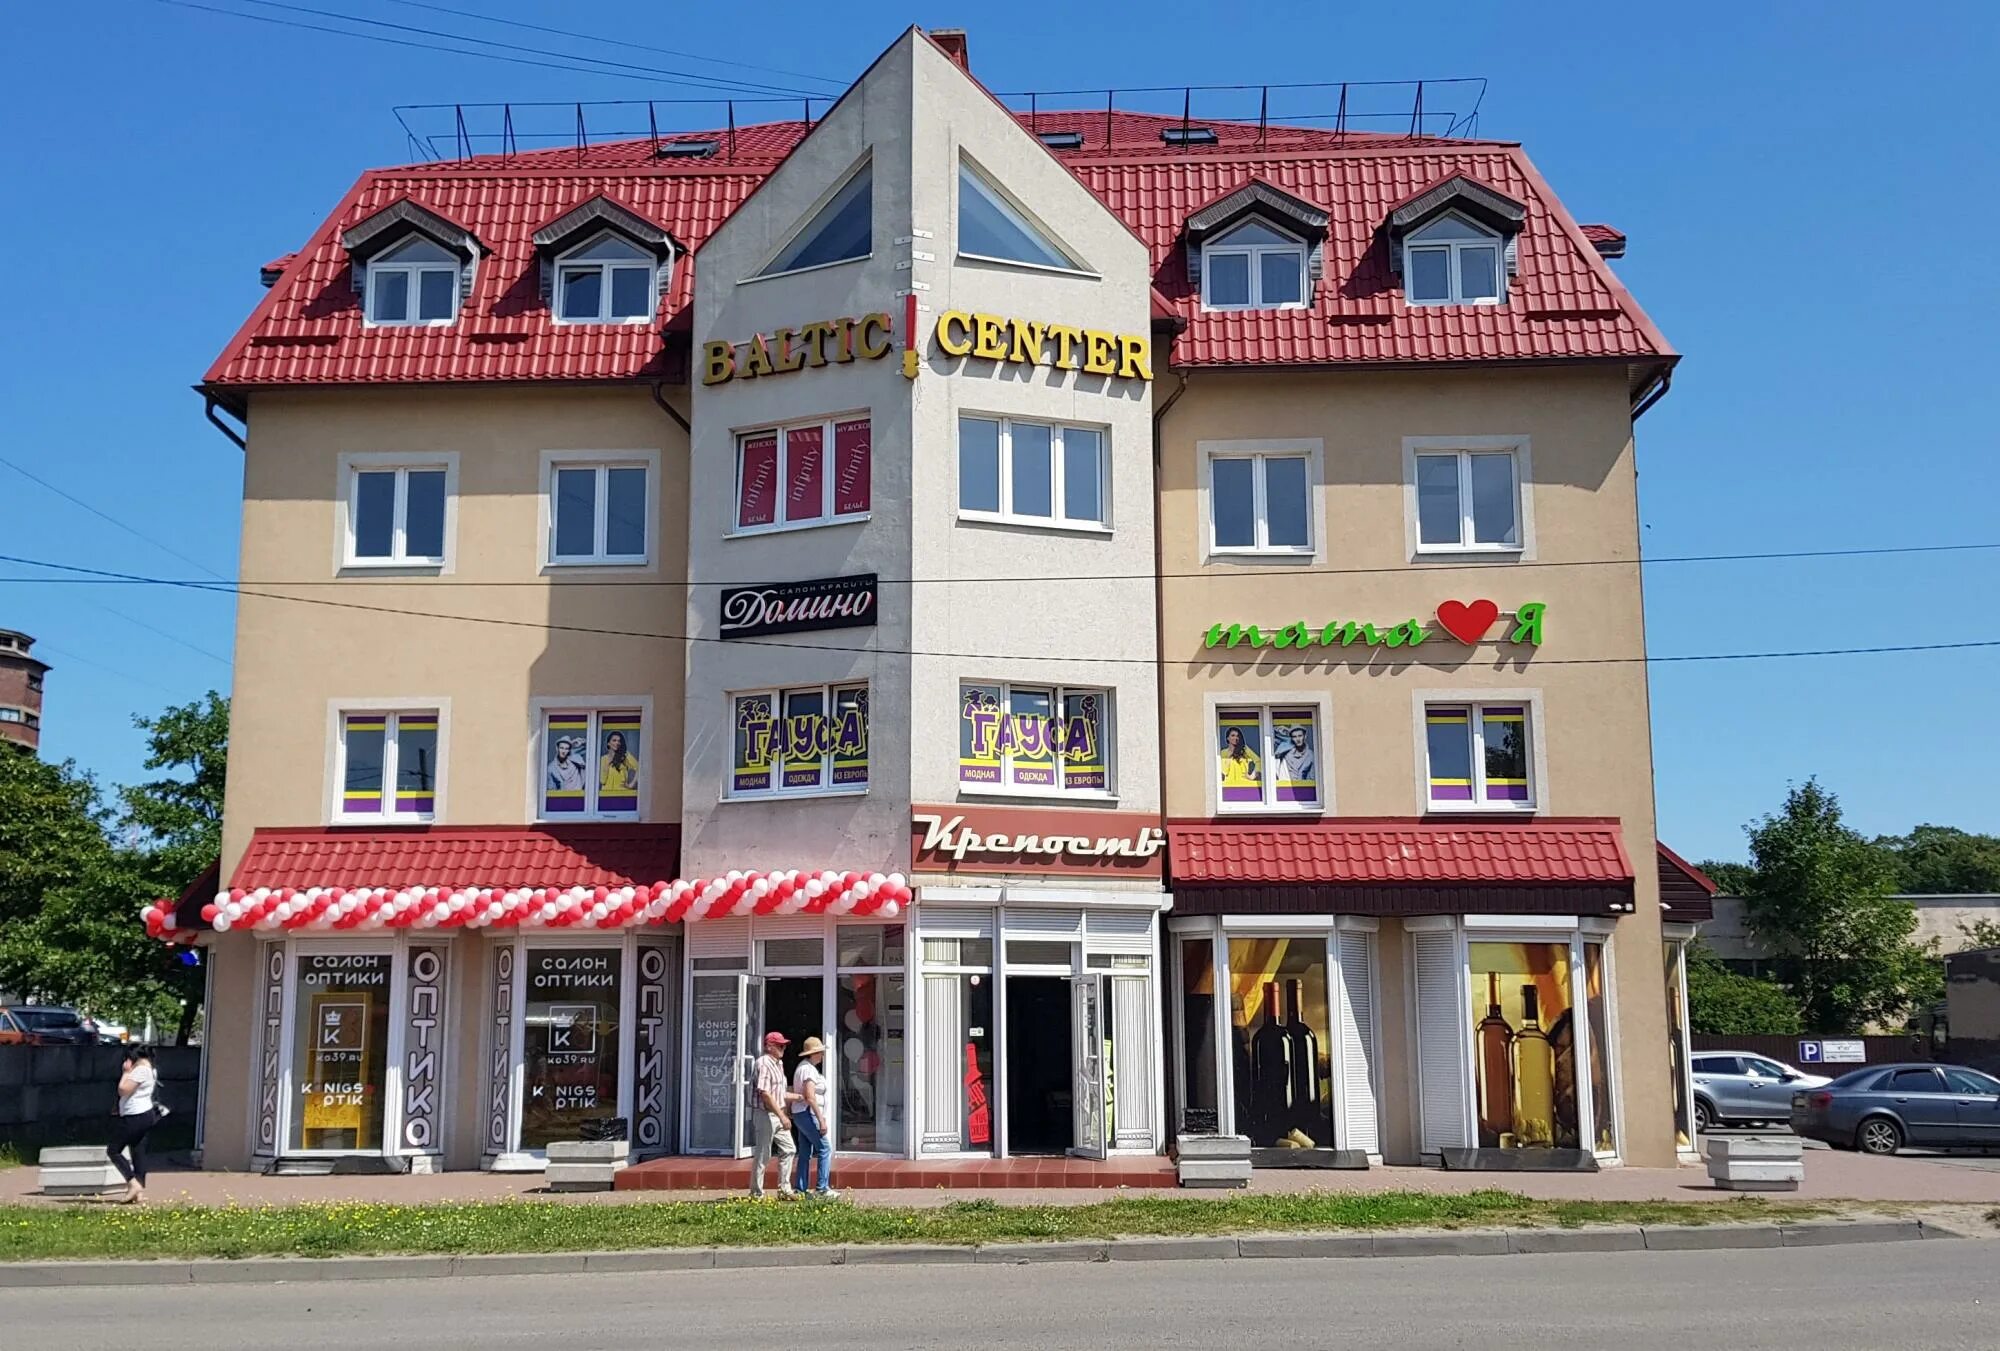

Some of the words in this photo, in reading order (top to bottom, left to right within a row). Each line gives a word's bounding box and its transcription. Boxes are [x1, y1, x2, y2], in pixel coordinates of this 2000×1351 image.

[703, 312, 893, 385] BALTIC
[937, 309, 1153, 380] CENTER
[747, 440, 777, 449] ЖЕНСКО
[838, 438, 870, 495] infinity
[744, 455, 776, 508] infinity
[789, 446, 820, 502] infinity
[720, 589, 873, 630] Домино
[779, 586, 816, 596] САЛОН
[745, 710, 866, 767] ГАУСА
[971, 711, 1097, 761] ГАУСА
[740, 777, 766, 786] МОДНАЯ
[788, 773, 815, 785] ОДЕЖДА
[965, 769, 995, 779] МОДНАЯ
[1019, 772, 1048, 782] ОДЕЖДА
[1074, 775, 1104, 785] ЕВРОПЫ
[912, 814, 1166, 859] Крепость
[1804, 1043, 1817, 1060] P
